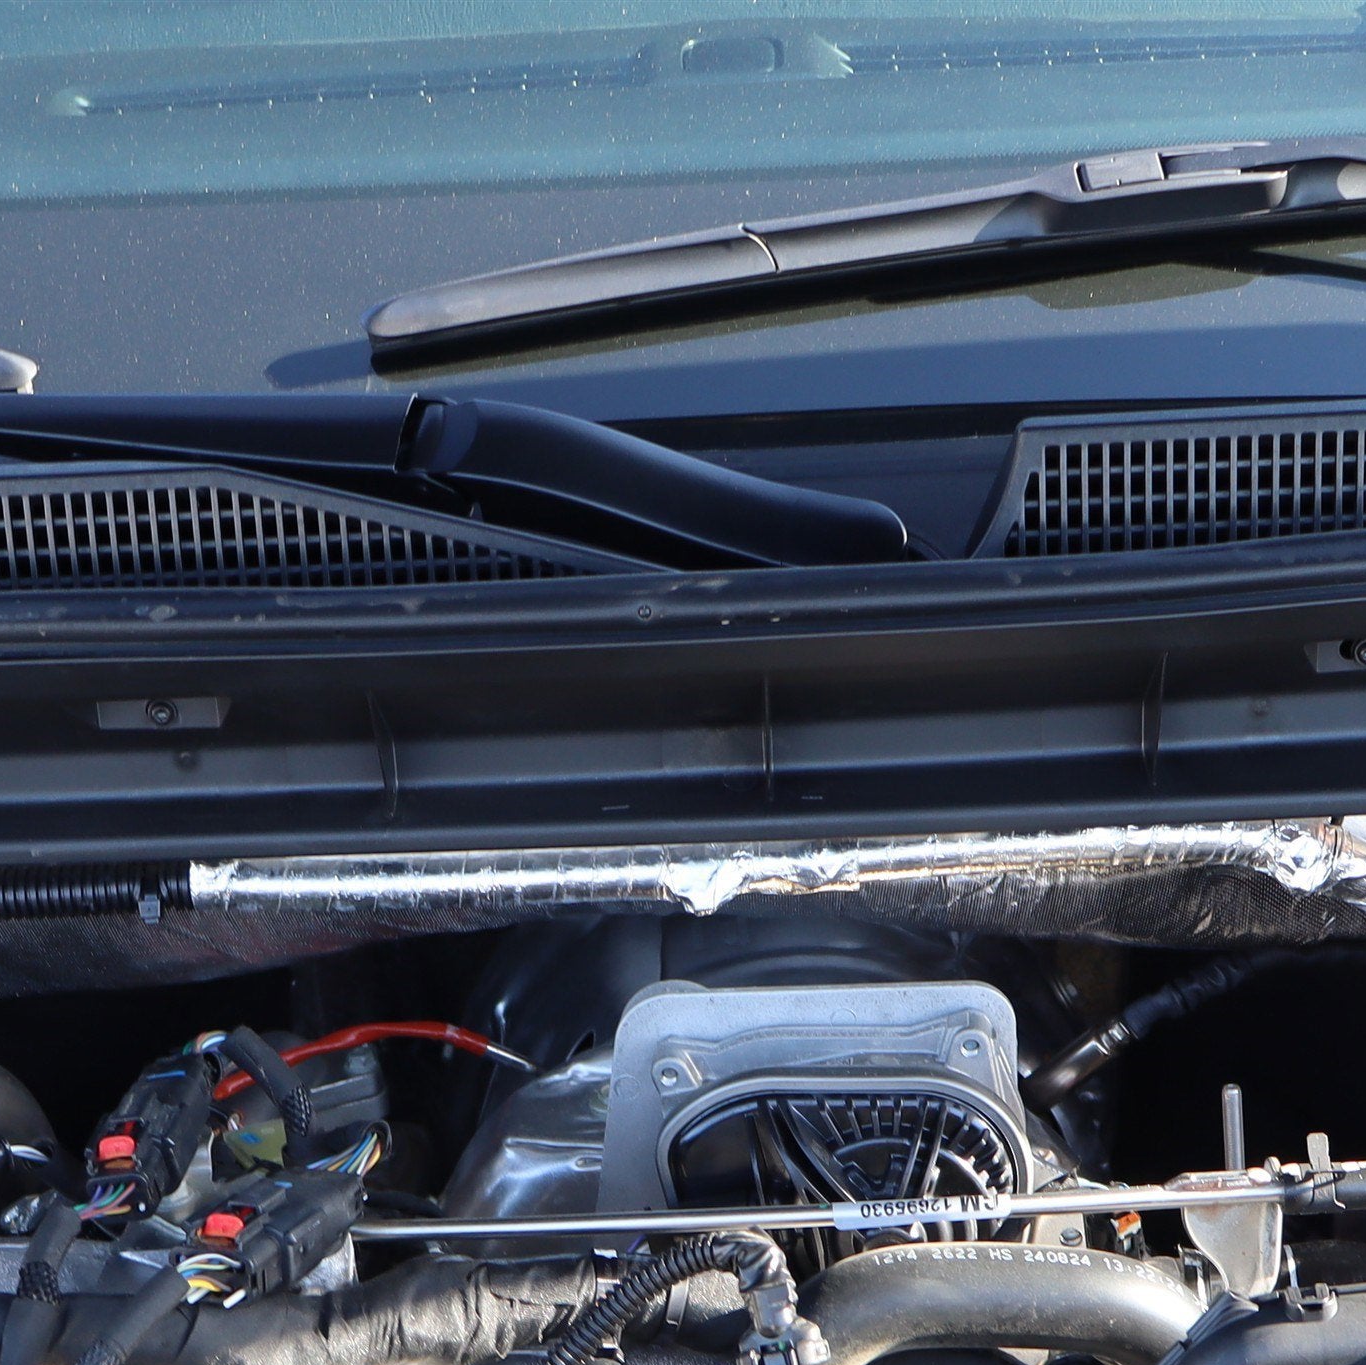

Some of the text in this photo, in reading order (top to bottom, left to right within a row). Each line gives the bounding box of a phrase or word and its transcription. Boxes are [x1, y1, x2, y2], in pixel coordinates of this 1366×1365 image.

[860, 1197, 953, 1218] 12695930
[931, 1248, 979, 1261] 2622
[989, 1249, 1013, 1262] HS
